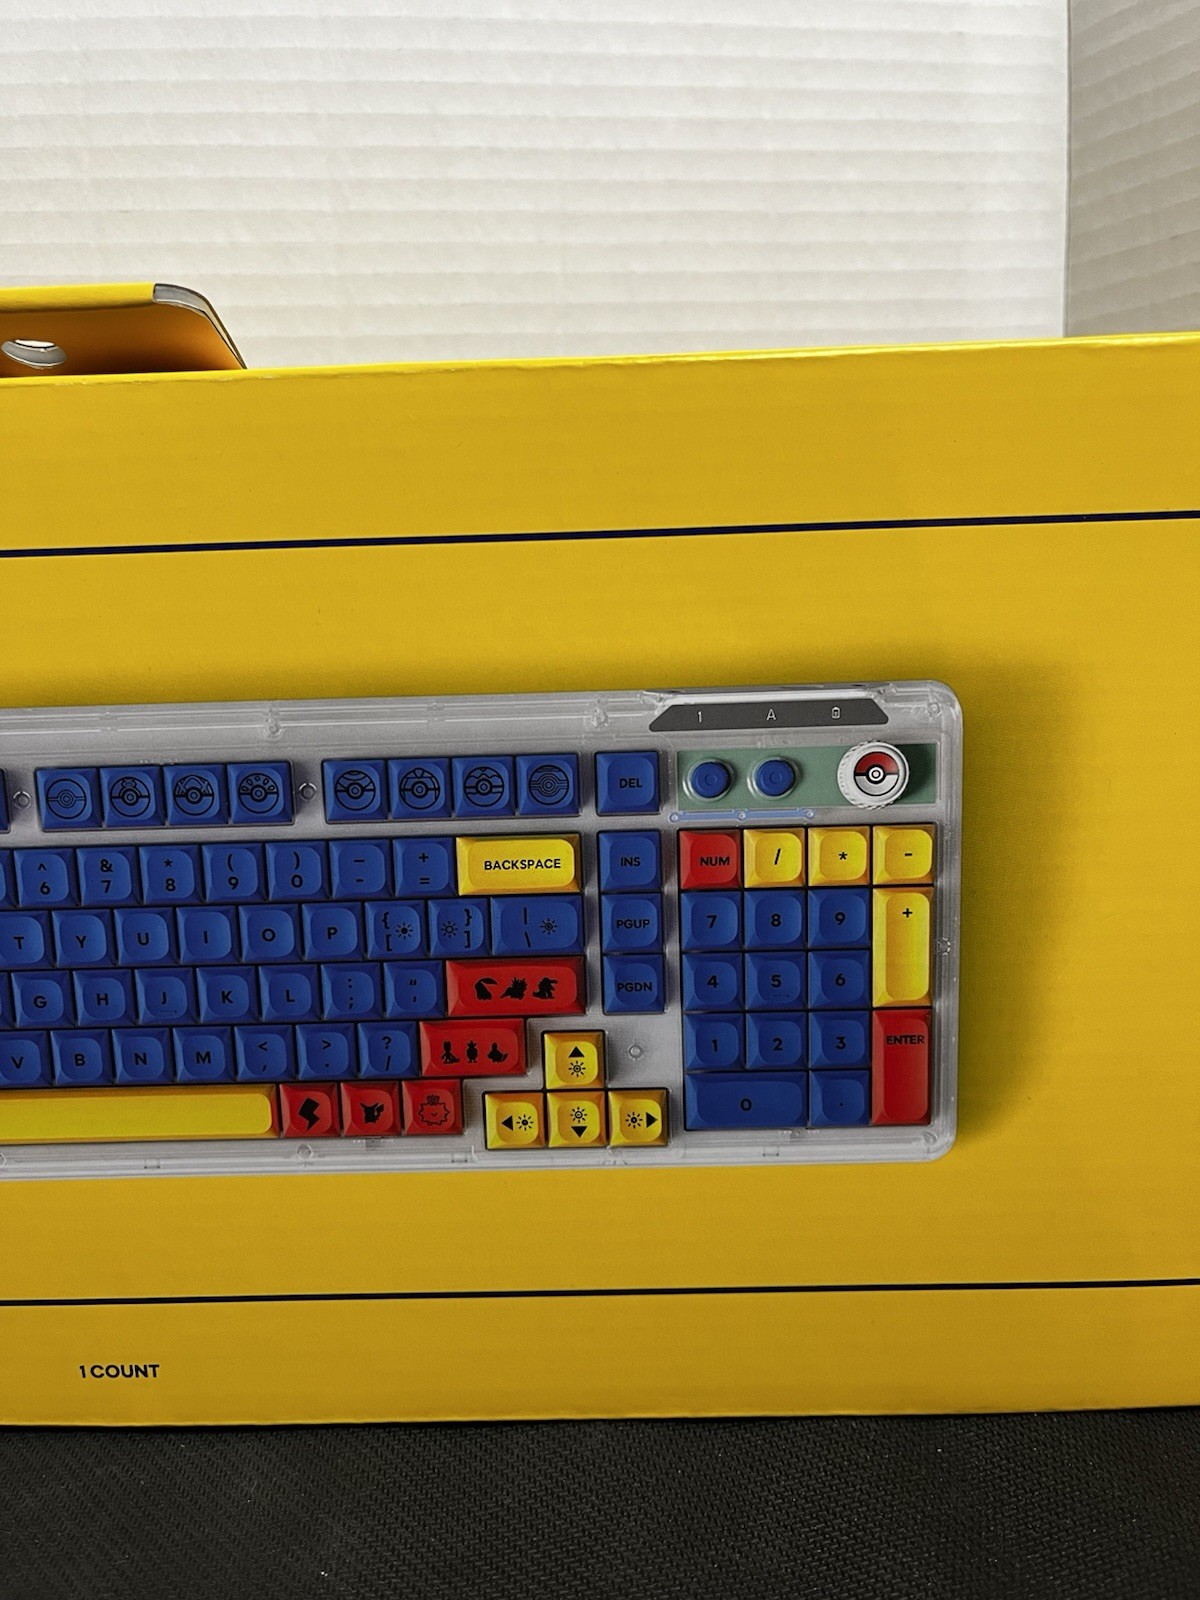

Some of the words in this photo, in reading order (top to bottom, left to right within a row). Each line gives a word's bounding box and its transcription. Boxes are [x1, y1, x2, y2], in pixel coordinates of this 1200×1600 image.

[766, 709, 776, 721] A
[620, 778, 642, 789] DEL
[484, 858, 561, 870] BACKSPACE
[620, 857, 641, 867] INS
[700, 855, 730, 866] NUM
[40, 881, 50, 895] 6
[101, 880, 112, 893] 7
[165, 878, 176, 892] 8
[228, 876, 239, 890] 9
[616, 919, 650, 929] PGUP
[707, 915, 717, 929] 7
[770, 913, 782, 927] 8
[835, 912, 845, 926] 9
[137, 932, 149, 946] U
[261, 928, 275, 942] O
[327, 926, 338, 940] P
[14, 936, 24, 949] T
[76, 935, 87, 948] Y
[617, 982, 652, 992] PGDN
[707, 975, 719, 989] 4
[770, 974, 782, 988] 5
[835, 973, 846, 987] 6
[33, 995, 47, 1009] G
[97, 993, 108, 1006] H
[161, 991, 167, 1005] J
[221, 990, 233, 1004] K
[285, 989, 295, 1003] L
[711, 1039, 718, 1052] 1
[772, 1037, 783, 1051] 2
[836, 1036, 846, 1050] 3
[886, 1034, 925, 1045] ENTER
[11, 1056, 24, 1069] V
[75, 1053, 85, 1067] B
[135, 1052, 147, 1066] N
[196, 1051, 212, 1064] M
[79, 1365, 86, 1378] 1
[90, 1364, 160, 1378] COUNT
